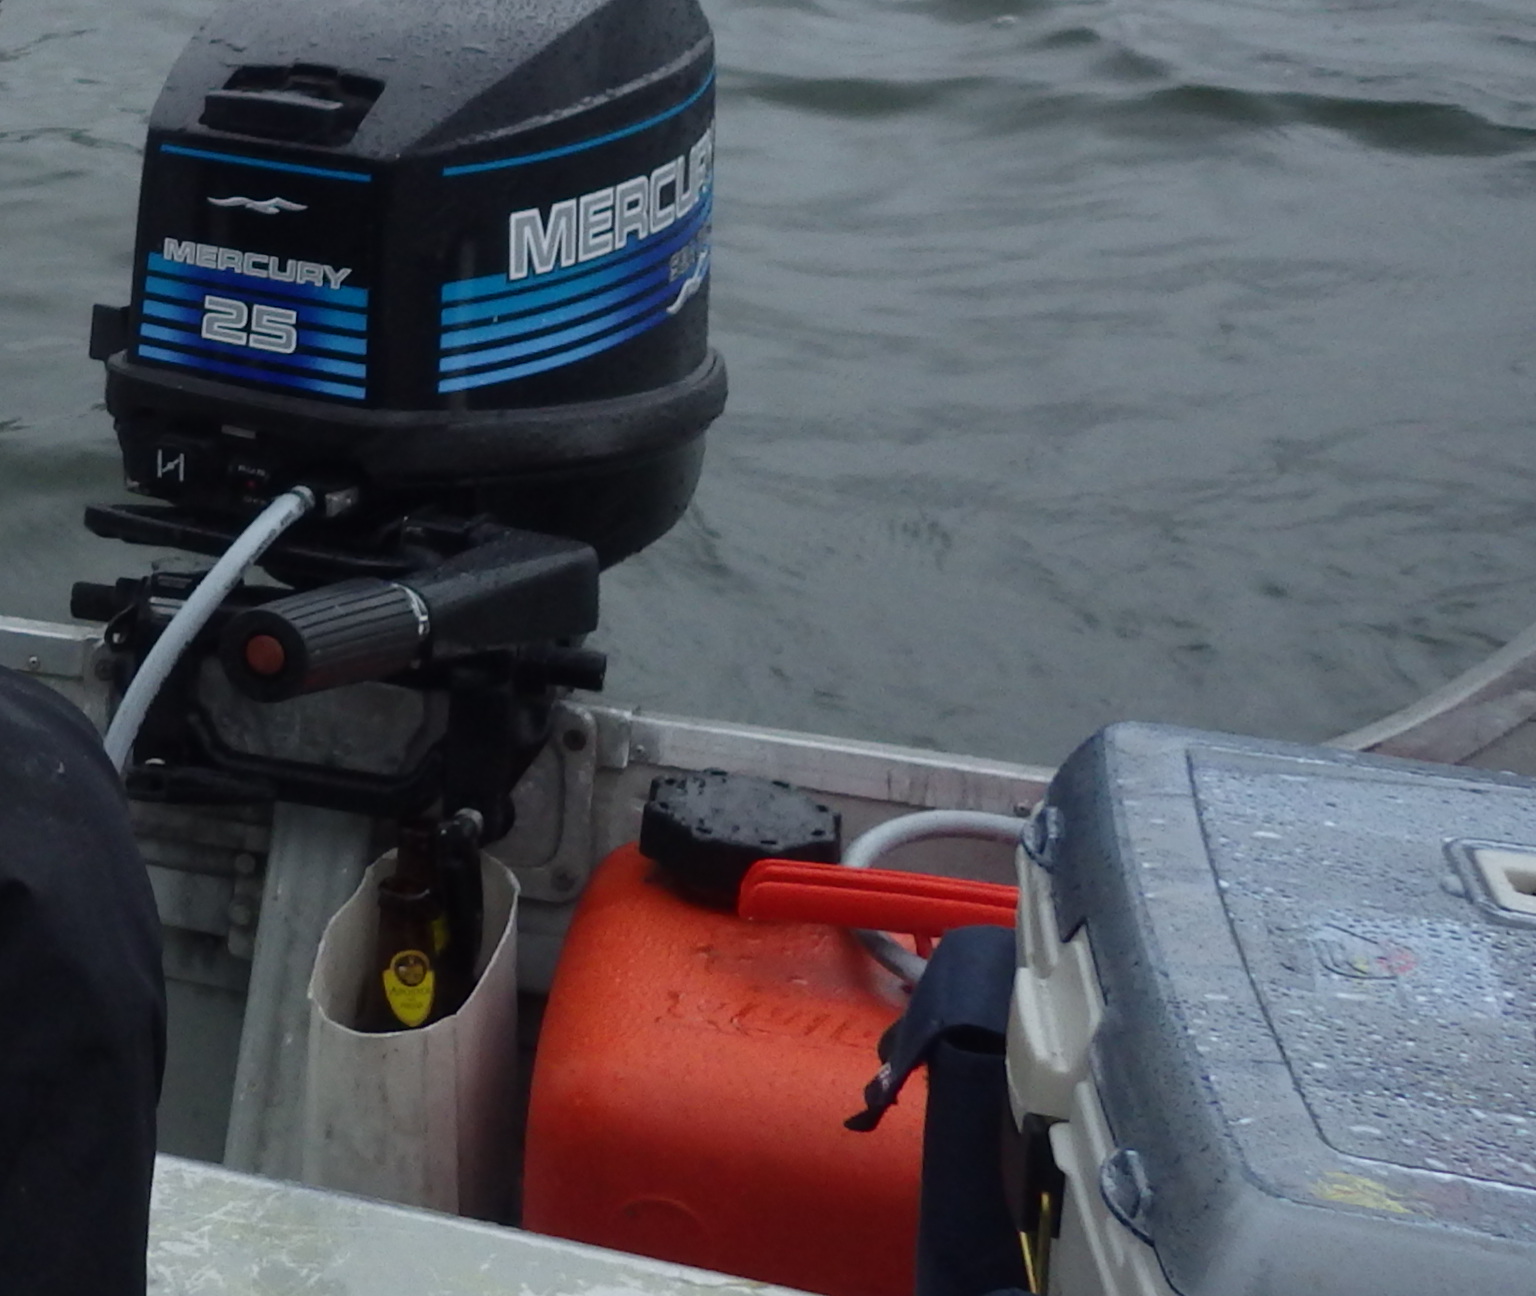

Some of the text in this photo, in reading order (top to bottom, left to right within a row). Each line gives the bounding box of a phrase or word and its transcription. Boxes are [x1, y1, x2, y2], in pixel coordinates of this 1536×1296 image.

[509, 120, 715, 281] MERCUR
[163, 237, 352, 289] MERCURY
[201, 295, 298, 354] 25
